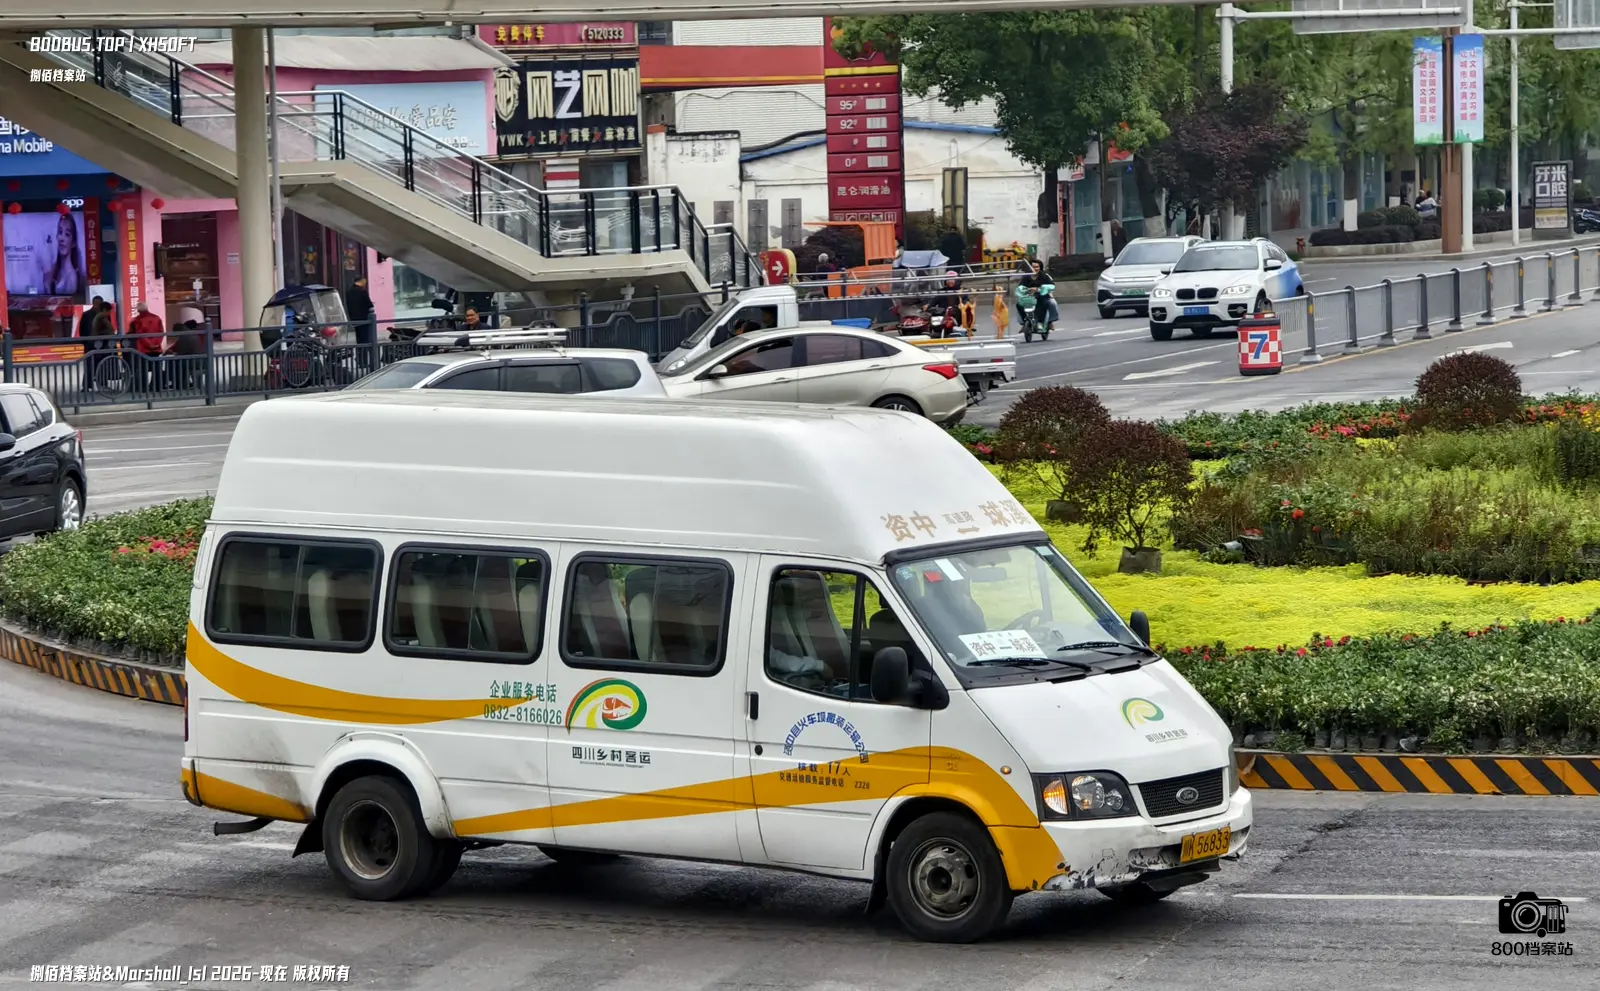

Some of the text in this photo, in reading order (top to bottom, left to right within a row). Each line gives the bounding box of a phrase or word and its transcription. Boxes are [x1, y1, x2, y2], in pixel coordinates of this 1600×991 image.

[496, 25, 625, 41] 免费停车 5120333
[13, 137, 53, 154] Mobile
[499, 133, 524, 147] YWK
[538, 130, 557, 145] 上网
[837, 185, 891, 197] 昆仑润滑油
[1535, 182, 1567, 198] 口腔
[1249, 333, 1268, 360] 7
[880, 510, 937, 542] 资中
[489, 679, 557, 703] 企业服务电话
[483, 703, 562, 725] 0832-8166026
[572, 746, 651, 764] 四川乡村客运
